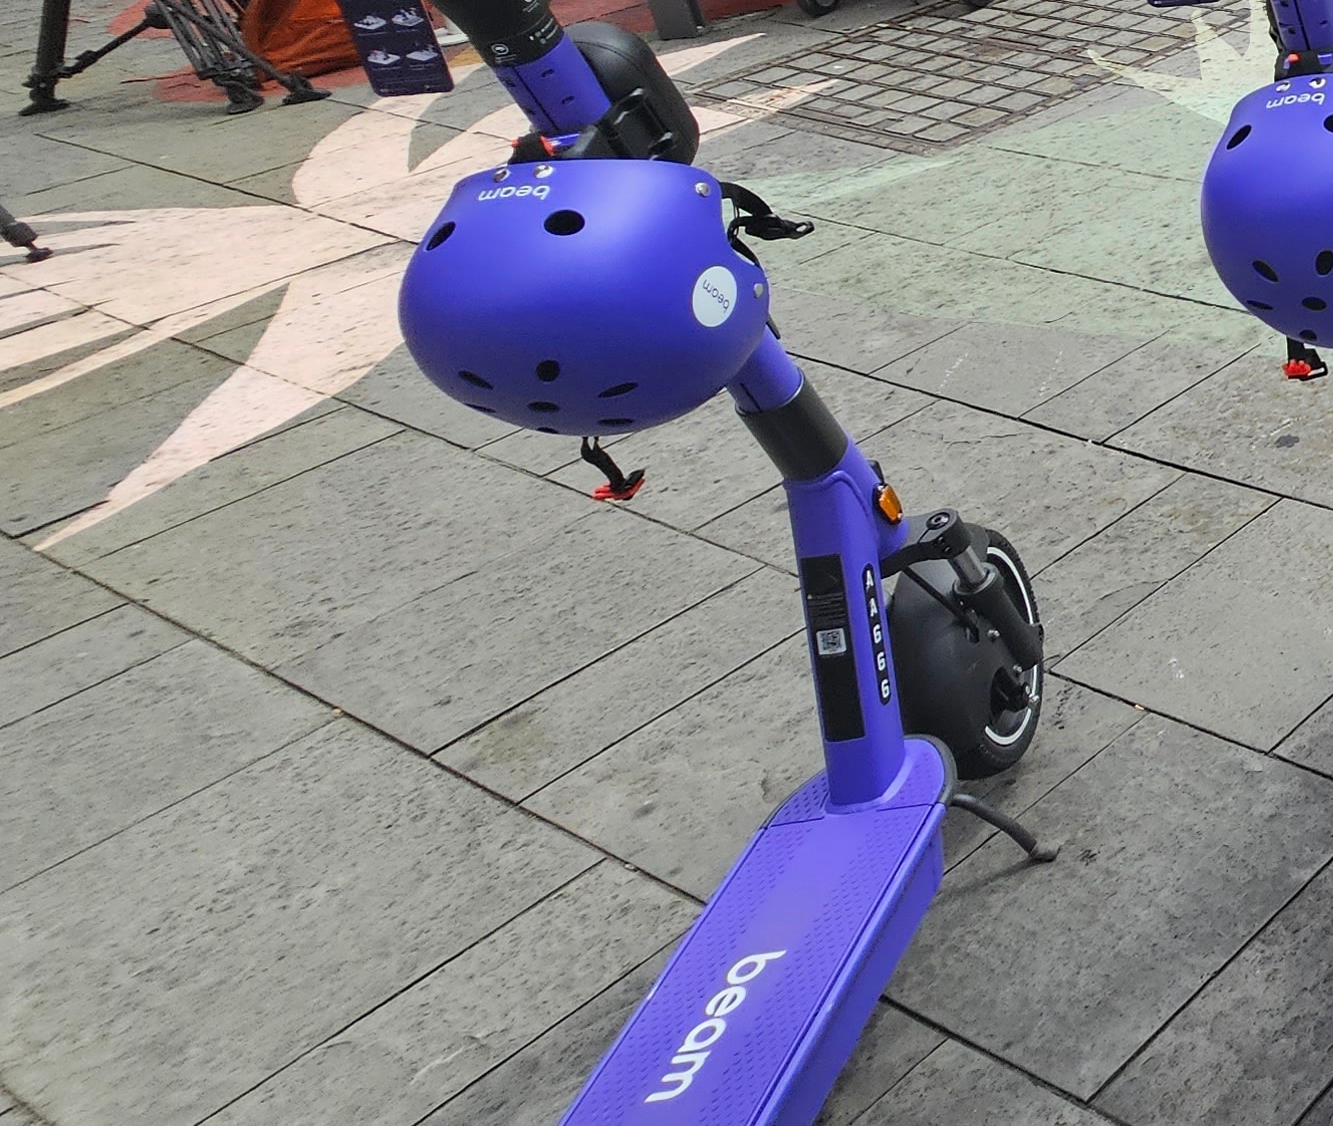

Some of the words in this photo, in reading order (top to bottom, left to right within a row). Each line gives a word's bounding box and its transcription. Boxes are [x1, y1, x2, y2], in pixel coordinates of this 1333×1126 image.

[1265, 92, 1326, 109] beam
[478, 184, 551, 201] beam
[702, 278, 730, 313] beam
[643, 949, 788, 1104] beam
